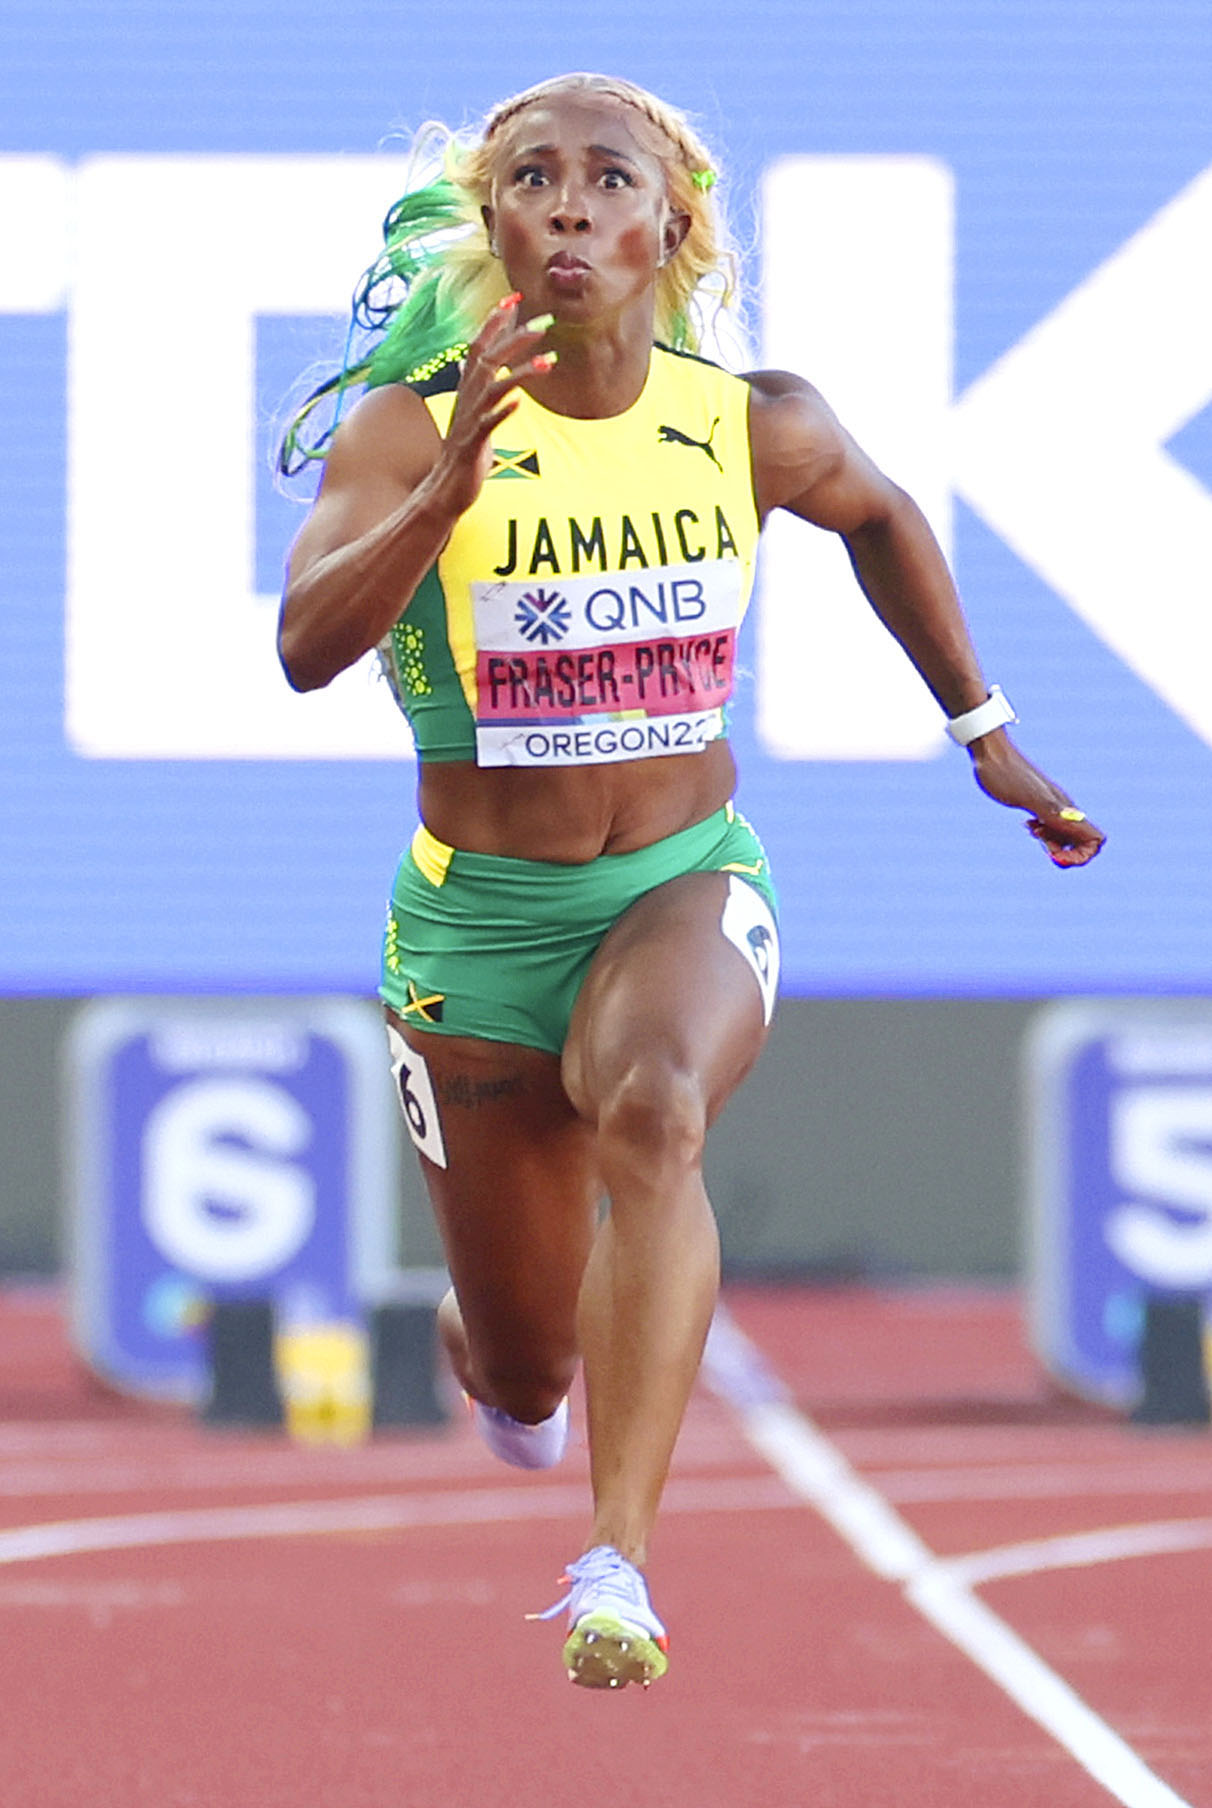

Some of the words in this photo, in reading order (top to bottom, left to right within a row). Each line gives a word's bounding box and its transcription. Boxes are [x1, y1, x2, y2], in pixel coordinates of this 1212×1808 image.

[493, 505, 739, 576] JAMAICA
[584, 579, 707, 631] QNB
[488, 636, 728, 709] FRASER-PRYCE
[400, 1063, 426, 1139] 6
[141, 1074, 316, 1283] 6
